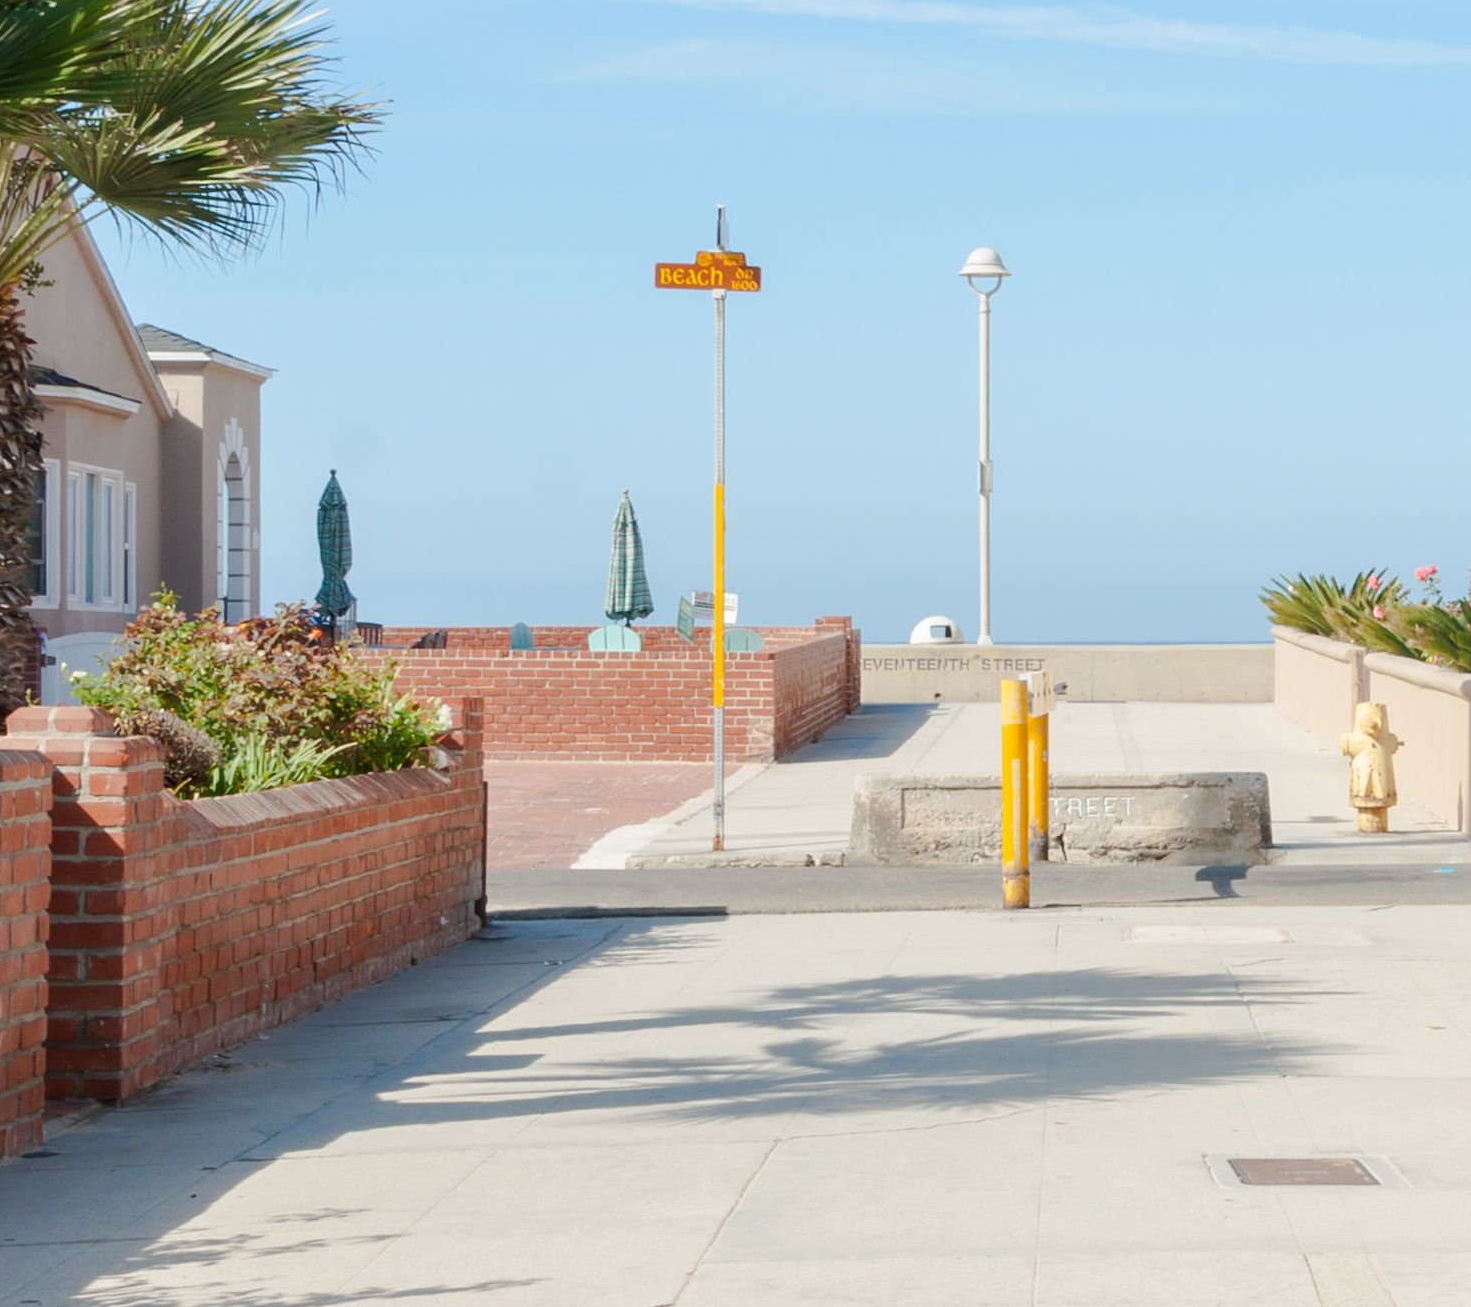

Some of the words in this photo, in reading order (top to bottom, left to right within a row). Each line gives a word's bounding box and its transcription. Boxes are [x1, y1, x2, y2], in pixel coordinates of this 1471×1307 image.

[659, 266, 724, 286] BEACH
[735, 268, 754, 279] DR
[731, 280, 758, 290] 1600
[862, 658, 970, 671] EVENTEENTH
[981, 658, 1046, 671] STREET
[1048, 796, 1135, 818] TREET
